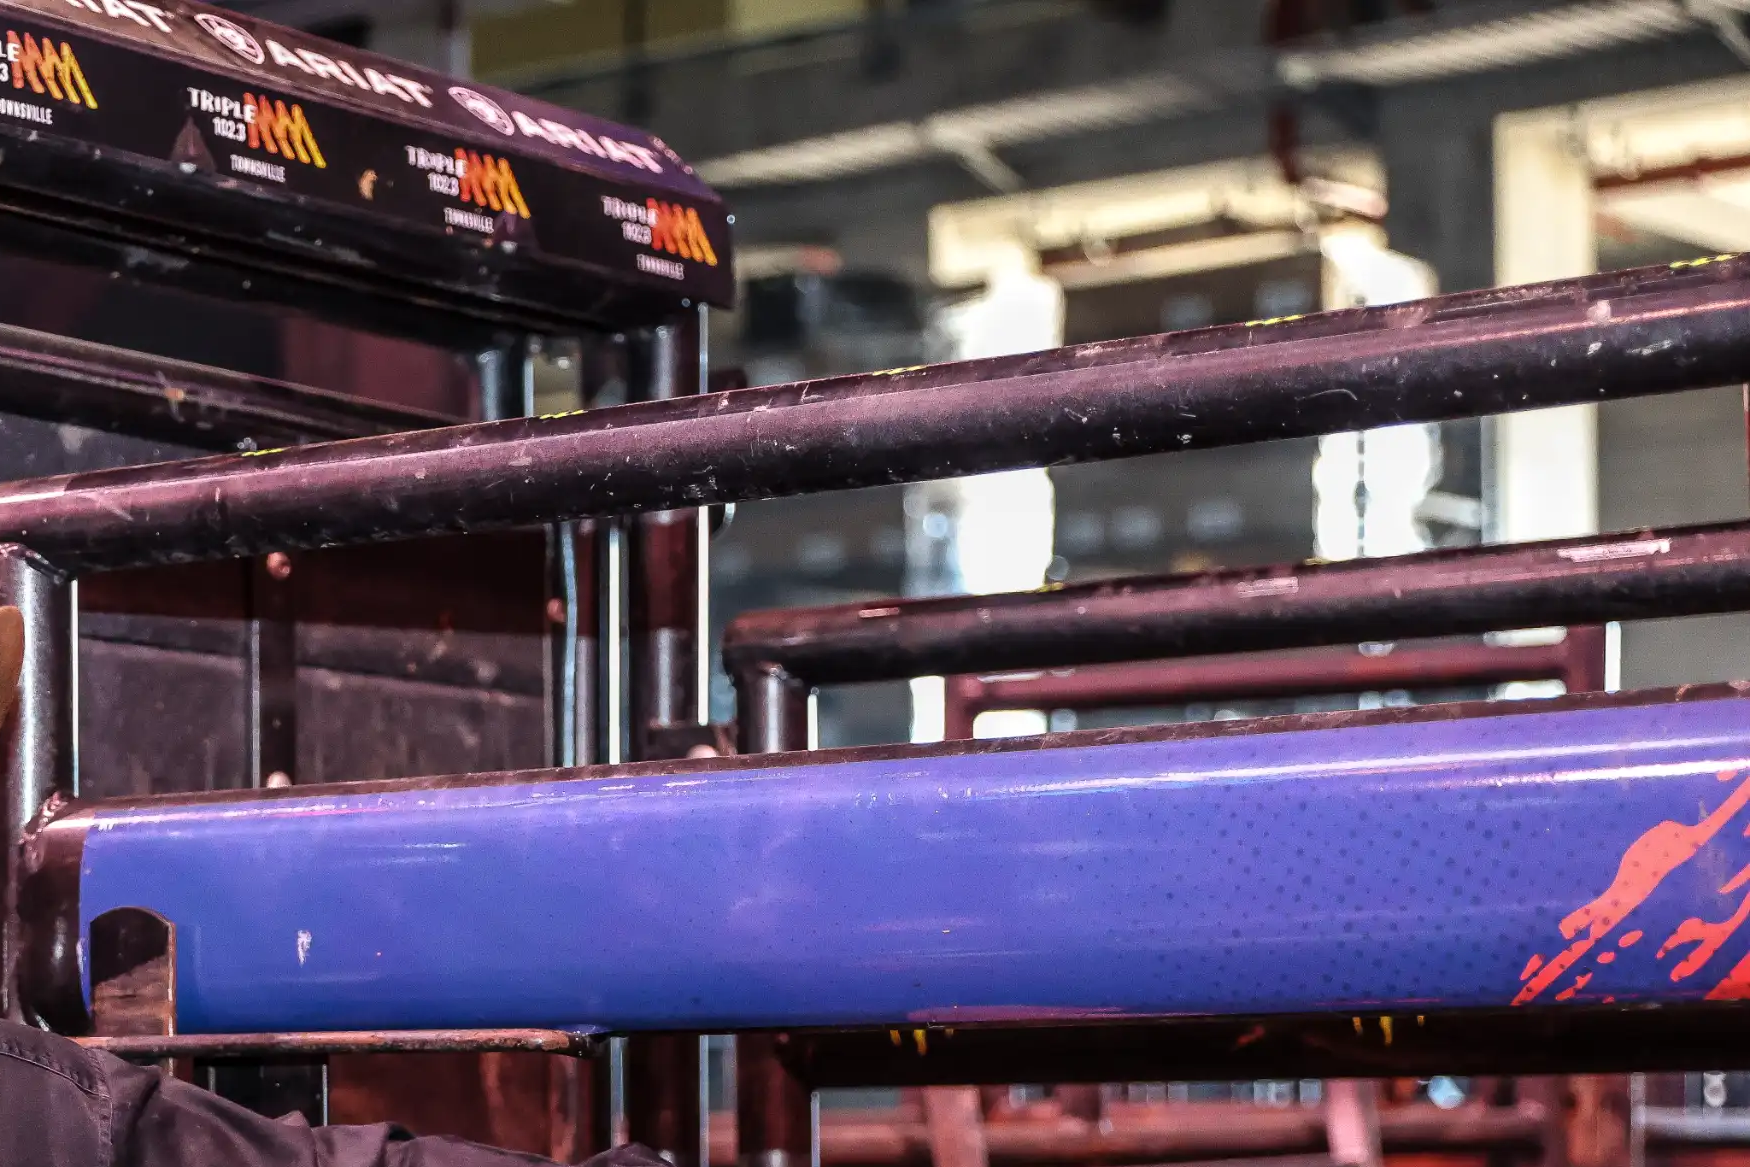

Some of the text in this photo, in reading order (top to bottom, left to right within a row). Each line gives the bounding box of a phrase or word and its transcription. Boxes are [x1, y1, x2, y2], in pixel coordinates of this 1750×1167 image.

[265, 39, 433, 108] ARIAT
[187, 86, 258, 124] TRIPLE
[212, 116, 247, 142] 102.3
[511, 110, 664, 174] ARIAT
